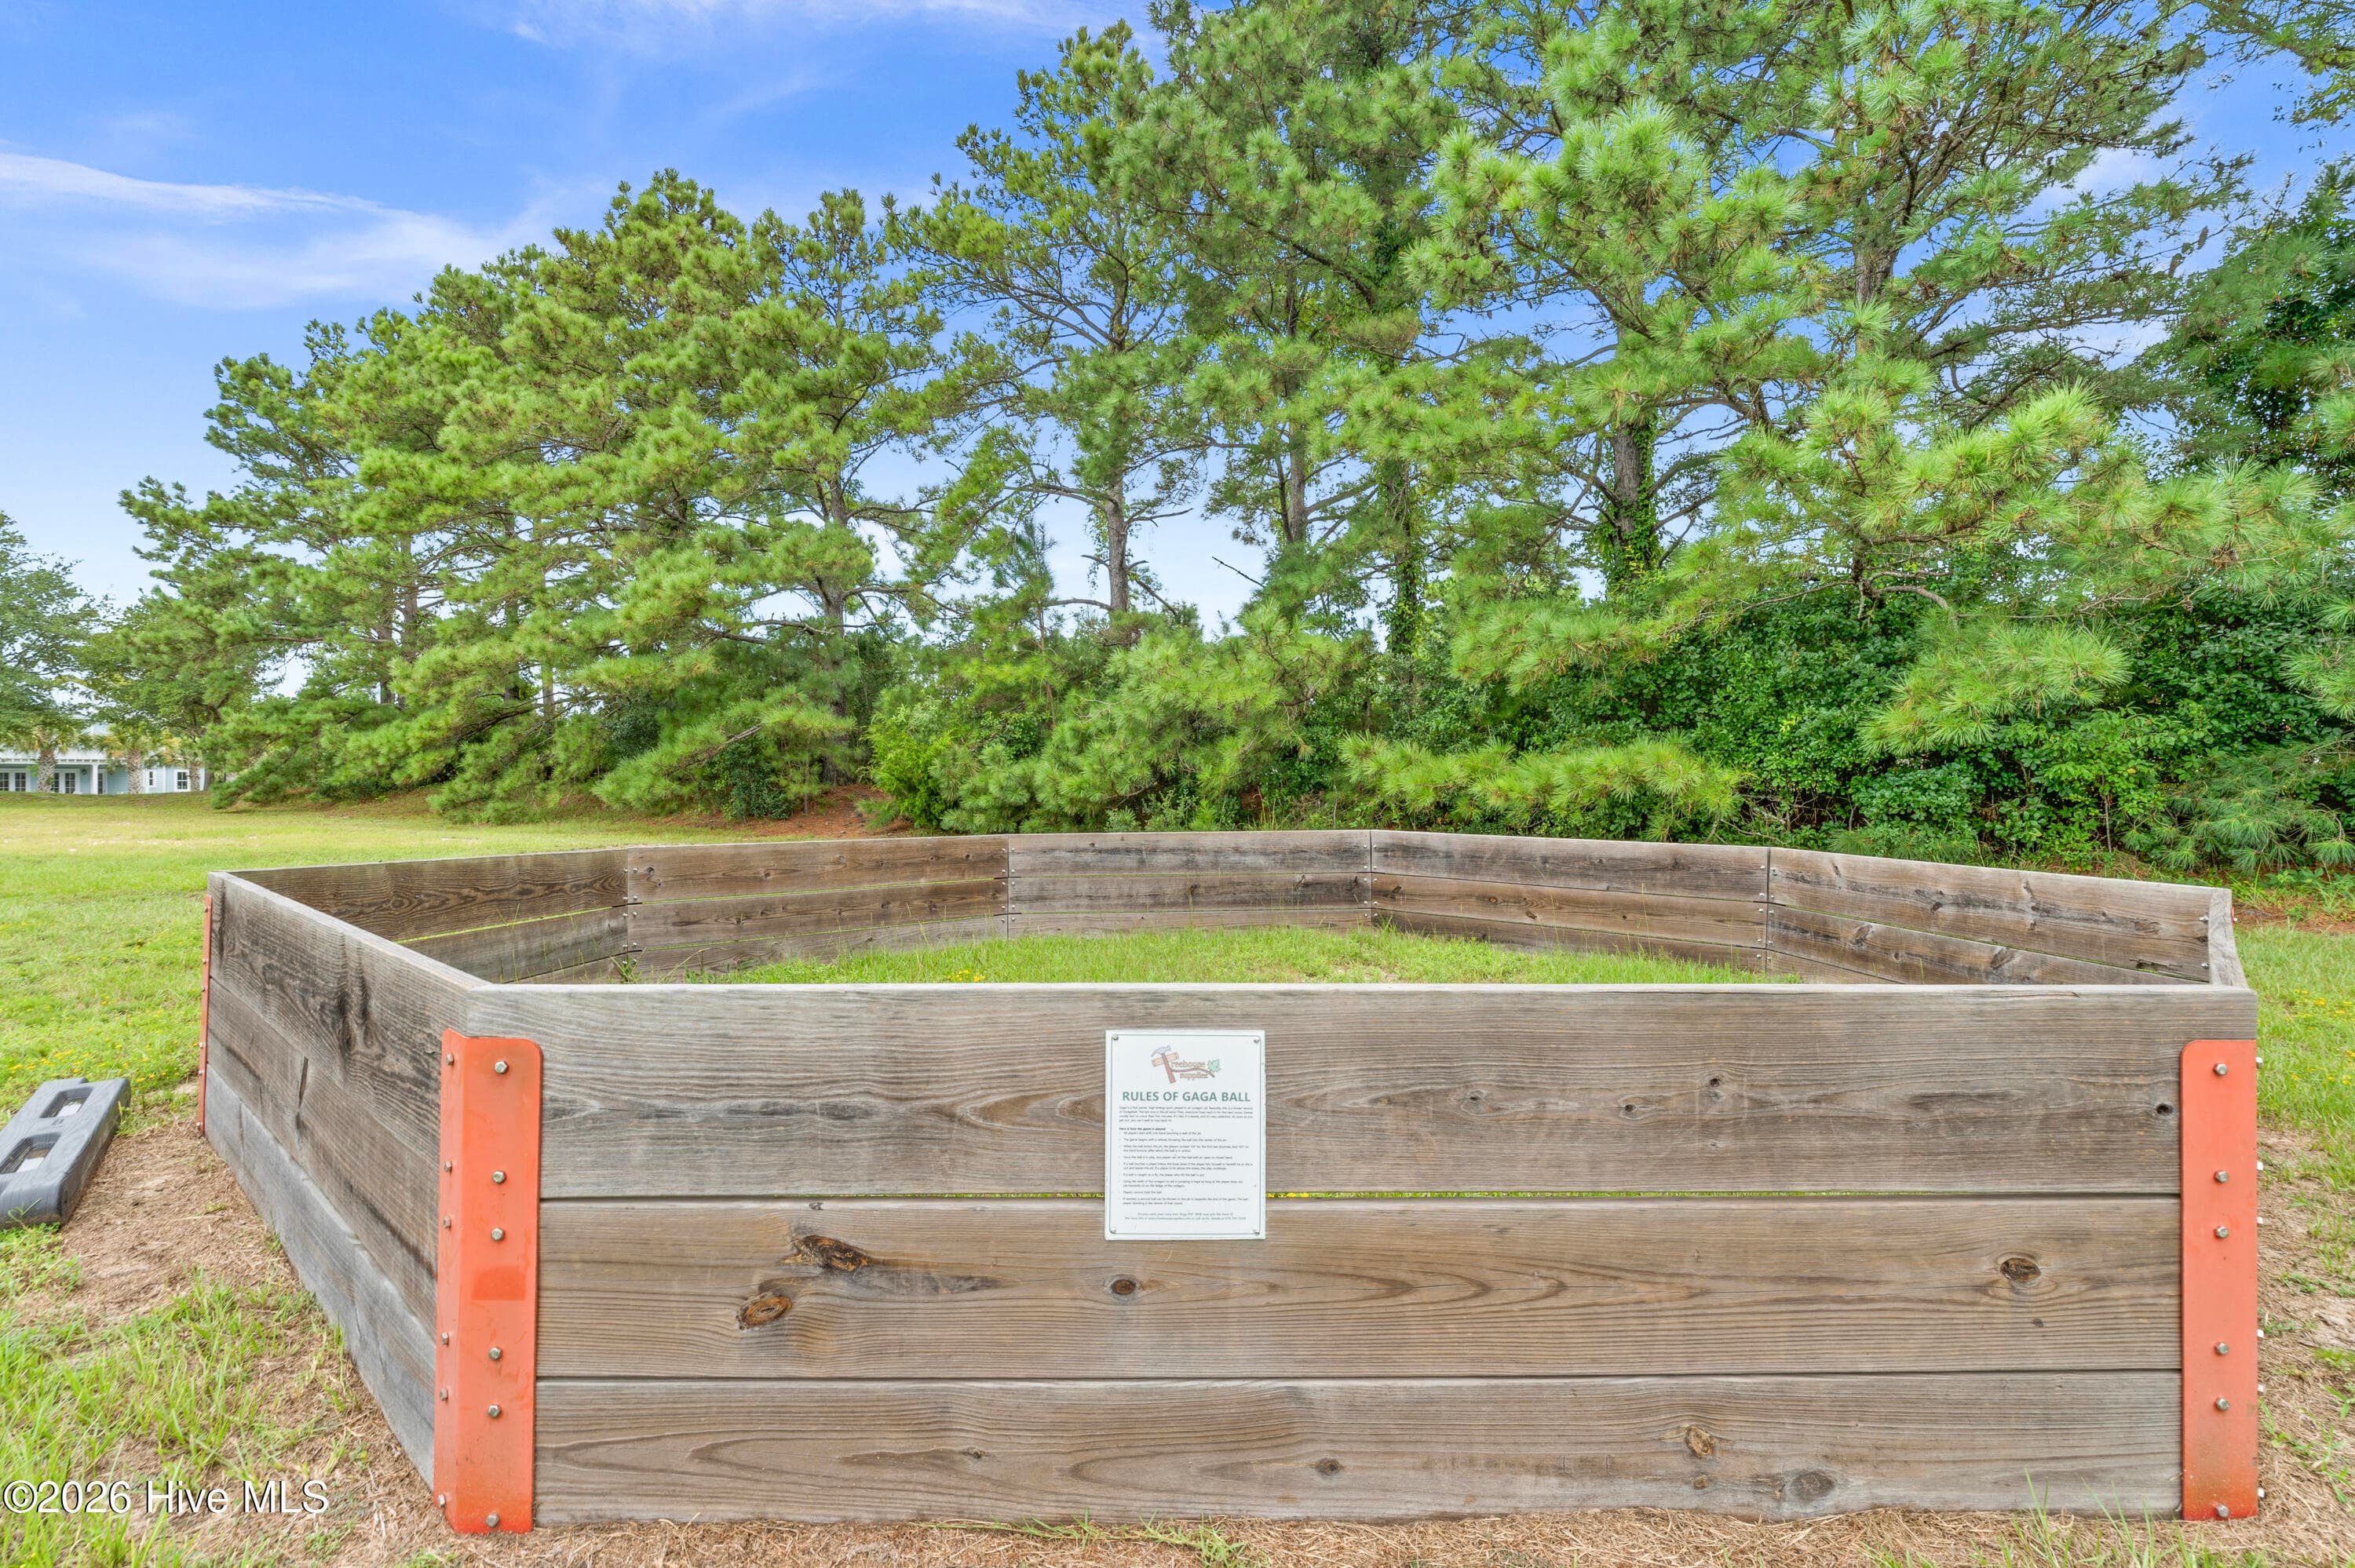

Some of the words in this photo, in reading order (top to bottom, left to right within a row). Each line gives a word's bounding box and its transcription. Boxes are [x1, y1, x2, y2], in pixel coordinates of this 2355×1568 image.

[1123, 1092, 1159, 1101] RULES
[1163, 1092, 1178, 1101] OF
[1182, 1092, 1218, 1102] GAGA
[1221, 1092, 1251, 1102] BALL
